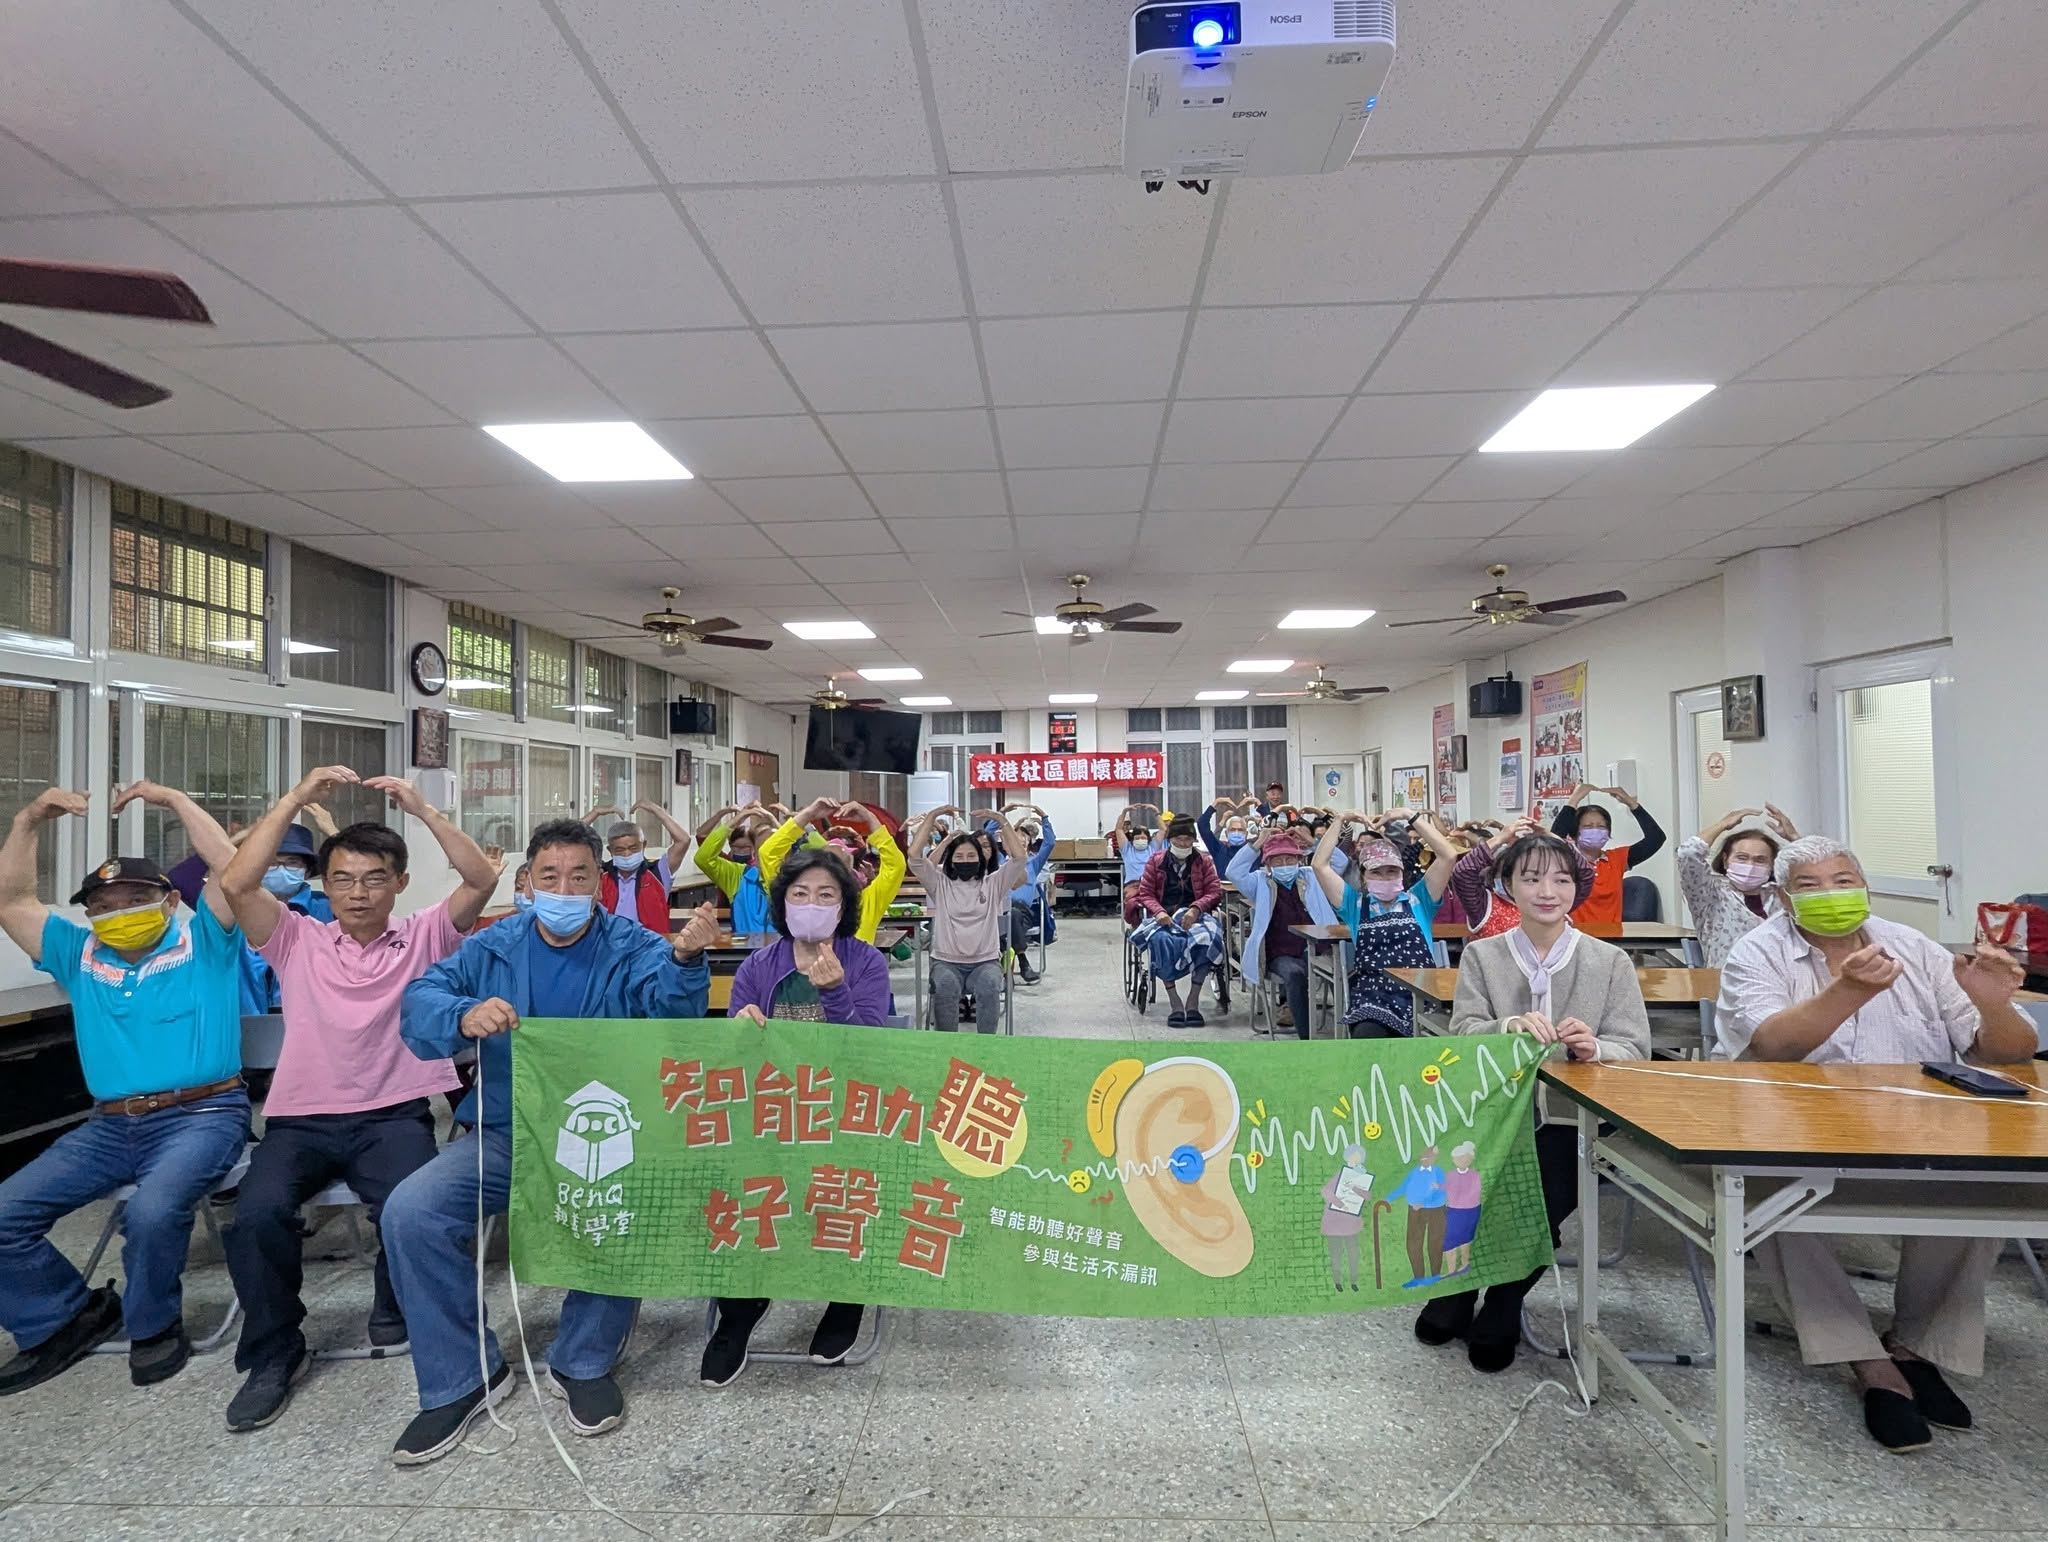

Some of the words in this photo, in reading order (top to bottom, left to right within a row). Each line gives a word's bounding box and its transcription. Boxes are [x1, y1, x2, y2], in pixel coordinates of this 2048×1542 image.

[1270, 15, 1302, 24] EPSON
[1232, 110, 1267, 119] EPSON
[660, 1057, 1028, 1166] 智能助聽
[558, 1182, 623, 1210] BenQ
[703, 1164, 965, 1278] 好聲音
[989, 1205, 1123, 1251] 智能助聽好聲音
[1023, 1243, 1158, 1287] 參與生活不漏訊
